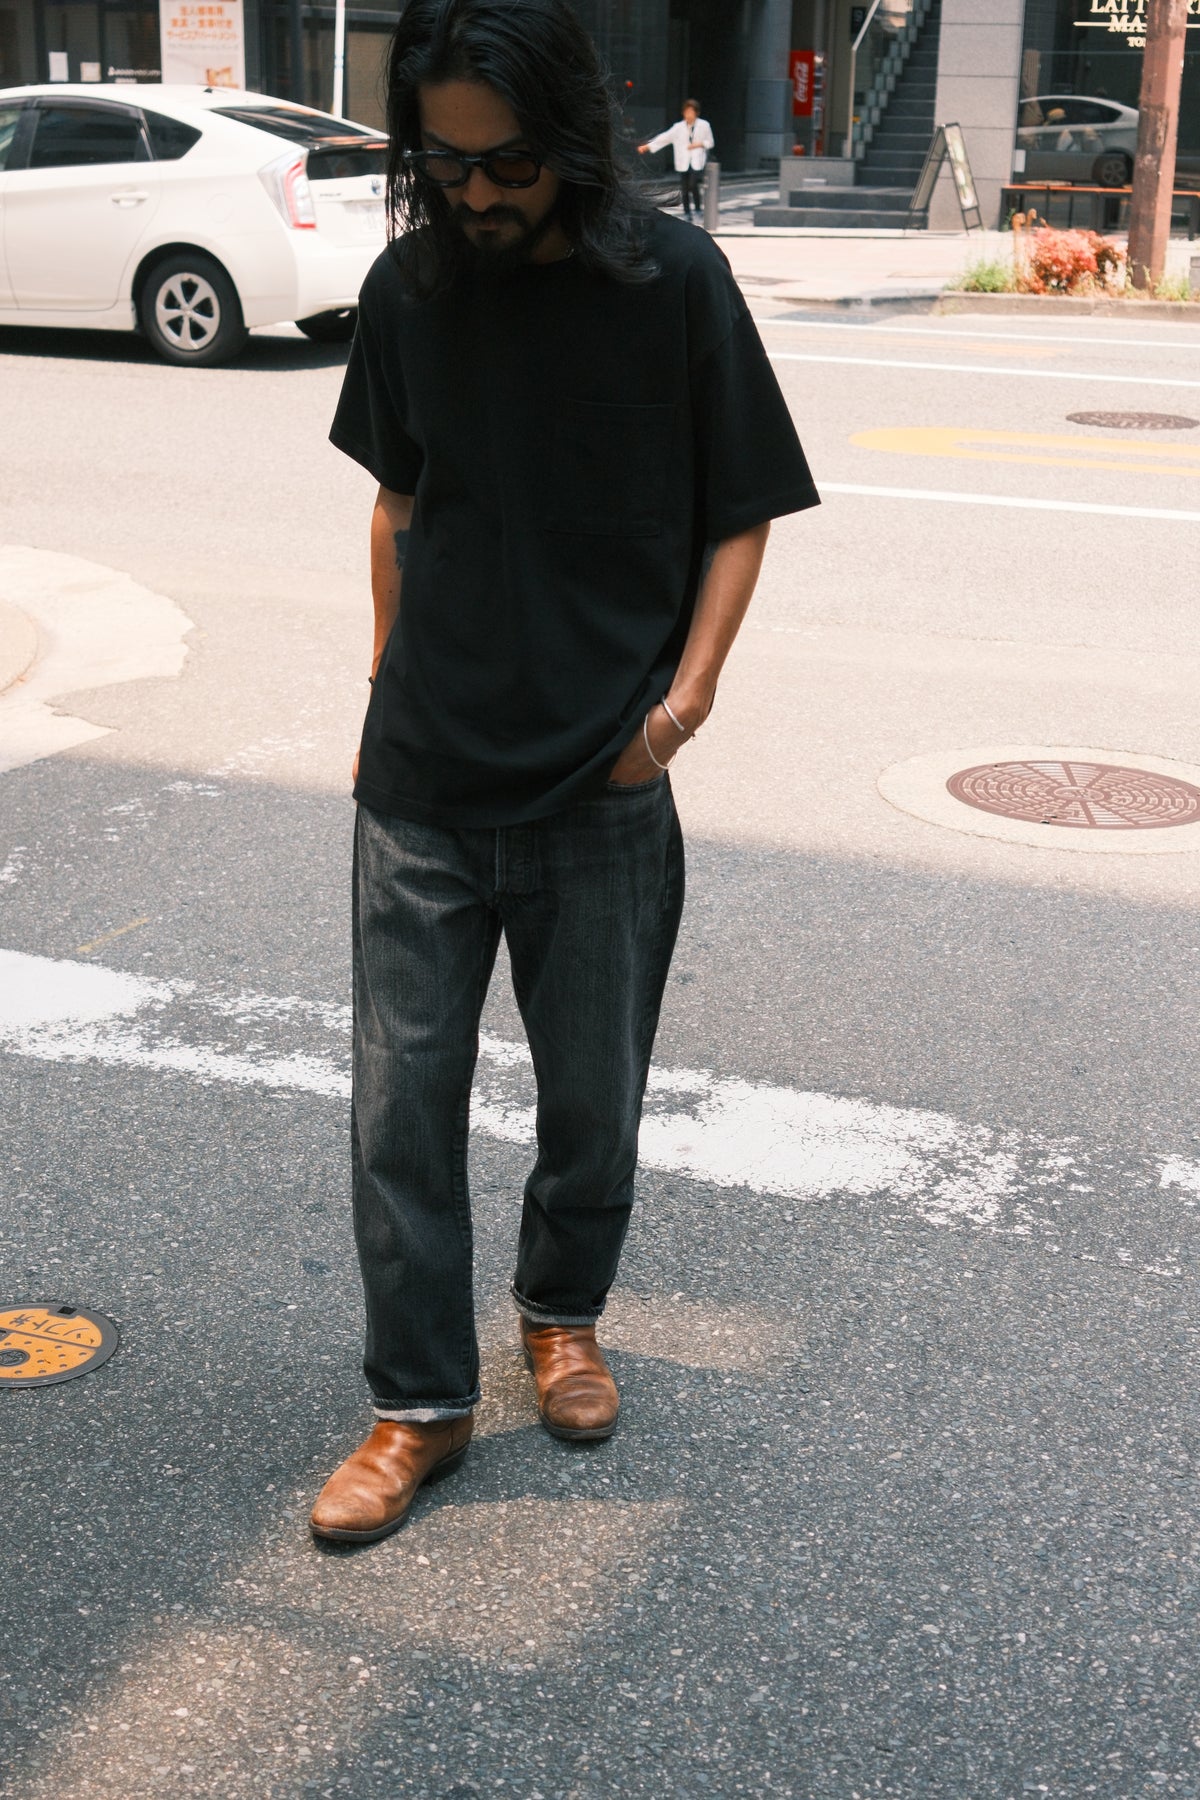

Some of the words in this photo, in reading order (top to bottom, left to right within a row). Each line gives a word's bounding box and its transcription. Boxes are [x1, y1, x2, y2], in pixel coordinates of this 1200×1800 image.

[1090, 0, 1148, 13] LATT
[1108, 15, 1148, 32] MA
[1127, 36, 1146, 47] TO
